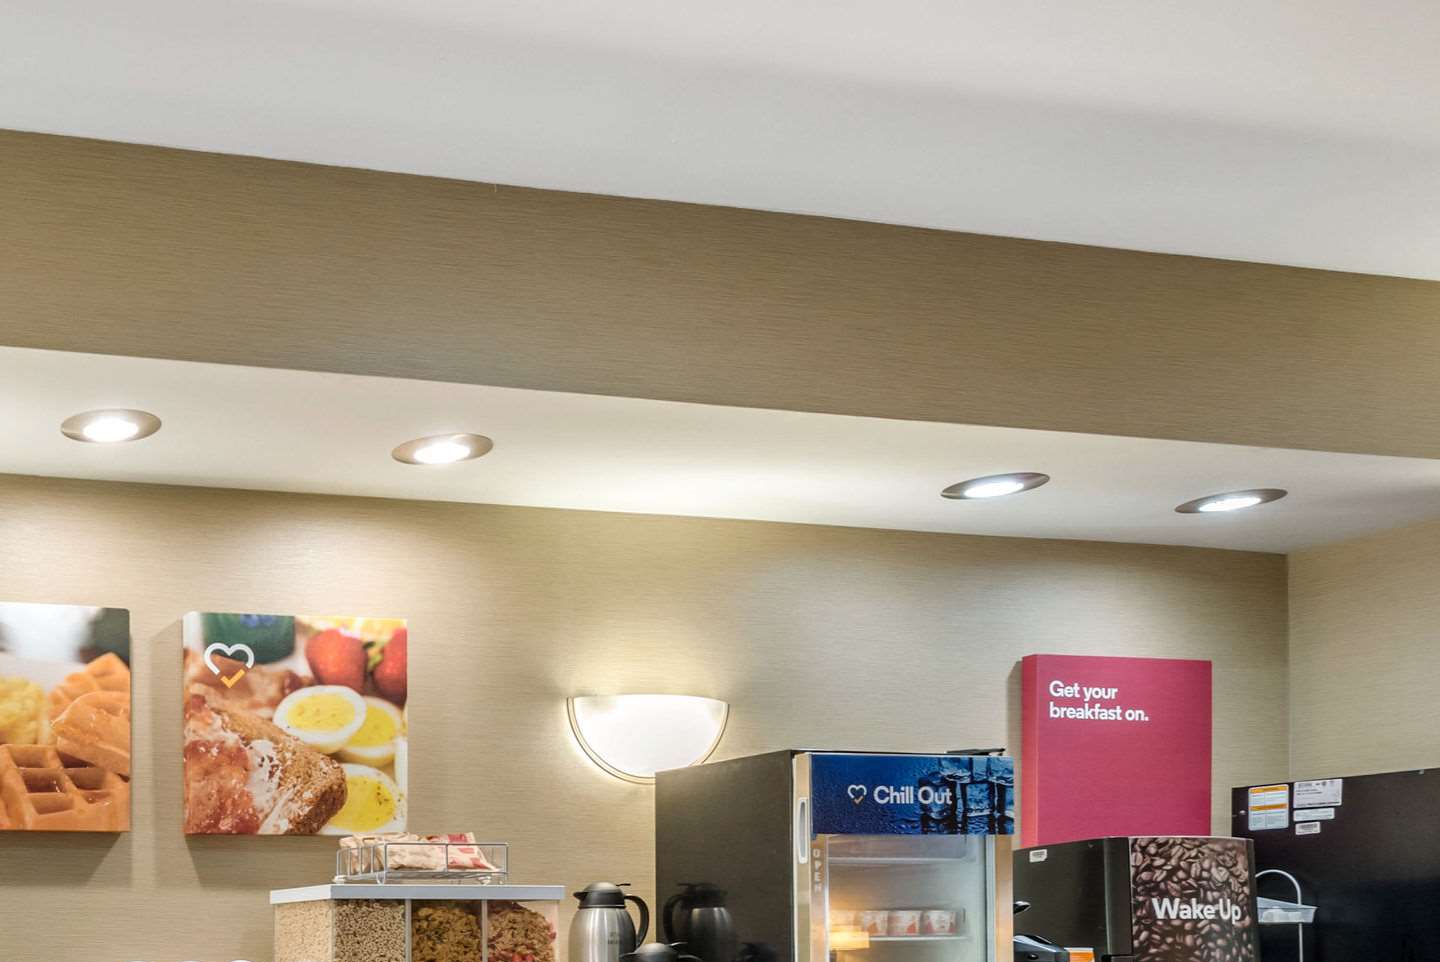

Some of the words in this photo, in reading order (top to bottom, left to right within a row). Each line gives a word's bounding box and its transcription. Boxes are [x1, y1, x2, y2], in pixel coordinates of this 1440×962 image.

[1049, 680, 1080, 698] Get
[1082, 686, 1118, 702] your
[1049, 701, 1123, 721] breakfast
[1125, 708, 1149, 722] on.
[873, 785, 914, 805] Chill
[917, 786, 953, 805] Out
[1151, 897, 1217, 920] Wake
[1219, 898, 1242, 925] Up
